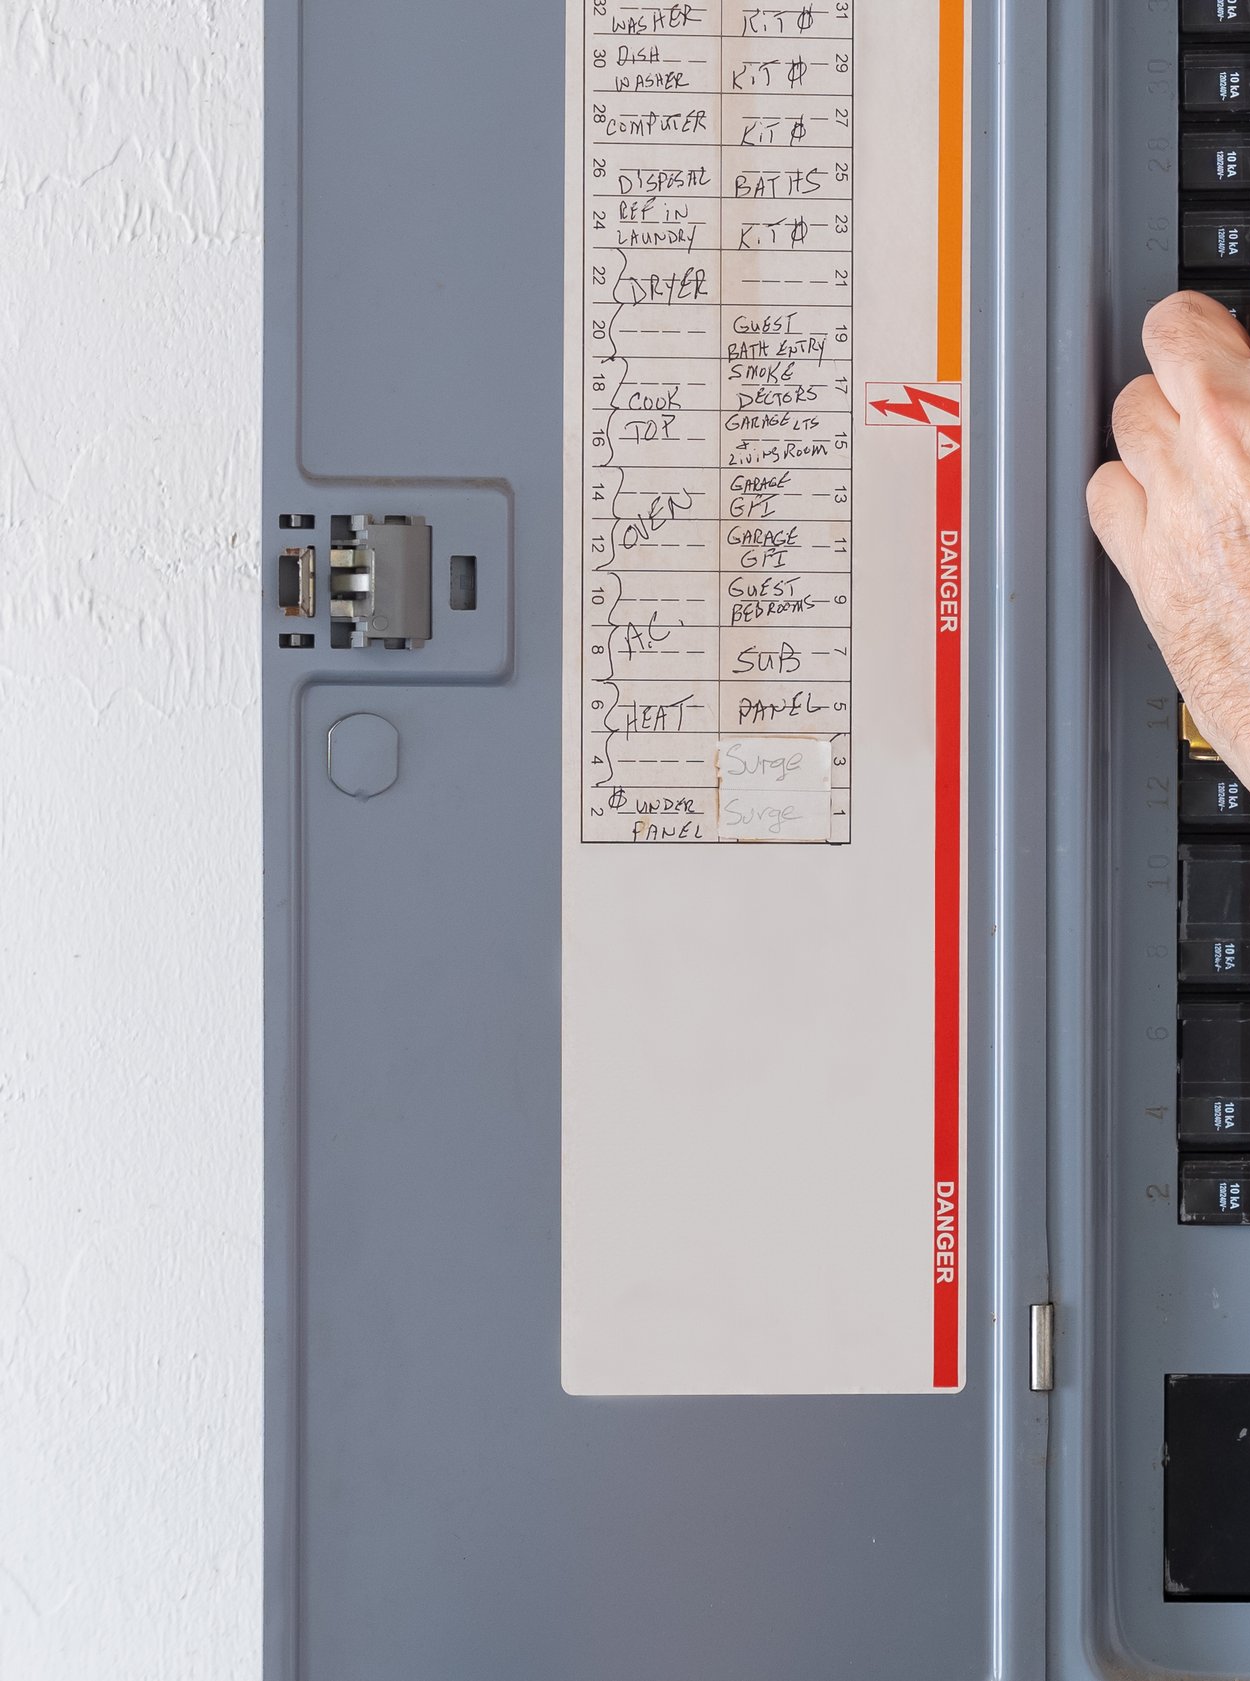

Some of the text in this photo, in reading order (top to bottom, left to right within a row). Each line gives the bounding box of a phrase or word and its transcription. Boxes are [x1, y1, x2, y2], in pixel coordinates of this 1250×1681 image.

[593, 0, 606, 16] 32
[836, 3, 848, 20] 31
[612, 4, 702, 34] WASHER
[593, 49, 606, 68] 30
[835, 54, 848, 73] 29
[615, 72, 689, 91] WASHER
[1230, 72, 1240, 98] 10 kA
[593, 104, 606, 123] 28
[606, 110, 707, 136] COMPUTER
[835, 108, 848, 127] 27
[593, 158, 606, 178] 26
[835, 163, 848, 182] 25
[1227, 151, 1237, 178] 10 kA
[735, 167, 821, 198] BATHS
[593, 211, 606, 230] 24
[835, 215, 848, 234] 23
[617, 225, 696, 254] LAUNDRY
[1229, 228, 1238, 255] 10 kA
[593, 266, 606, 285] 22
[835, 269, 848, 287] 21
[630, 267, 708, 306] DRYER
[592, 320, 605, 339] 20
[733, 312, 798, 333] GUEST
[835, 325, 848, 343] 19
[729, 337, 826, 367] BATH ENTRY
[728, 362, 795, 383] SMOKE
[593, 374, 605, 392] 18
[835, 376, 848, 394] 17
[628, 386, 681, 411] COOK
[624, 414, 675, 444] TOP
[725, 412, 789, 431] GARAGE
[591, 430, 605, 447] 16
[834, 432, 847, 450] 15
[591, 483, 605, 501] 14
[730, 471, 791, 494] GARAGE
[834, 486, 847, 504] 13
[623, 487, 693, 549] OVEN
[591, 535, 605, 553] 12
[727, 526, 798, 546] GARAGE
[834, 537, 847, 555] 11
[728, 576, 801, 597] GUEST
[941, 530, 958, 632] DANGER
[591, 587, 605, 605] 10
[834, 595, 847, 605] 9
[731, 594, 815, 626] BEDROOMS
[591, 645, 604, 655] 8
[732, 641, 801, 674] SUB
[834, 647, 847, 656] 7
[591, 699, 604, 709] 6
[739, 691, 822, 725] PANEL
[834, 702, 847, 711] 5
[626, 694, 694, 741] HEAT
[591, 755, 604, 765] 4
[726, 743, 803, 781] Surge
[833, 757, 846, 766] 3
[590, 808, 604, 817] 2
[635, 796, 696, 814] UNDER
[724, 798, 802, 834] Surge
[632, 821, 703, 840] PANEL
[1230, 1183, 1240, 1210] 10 kA
[937, 1181, 954, 1284] DANGER
